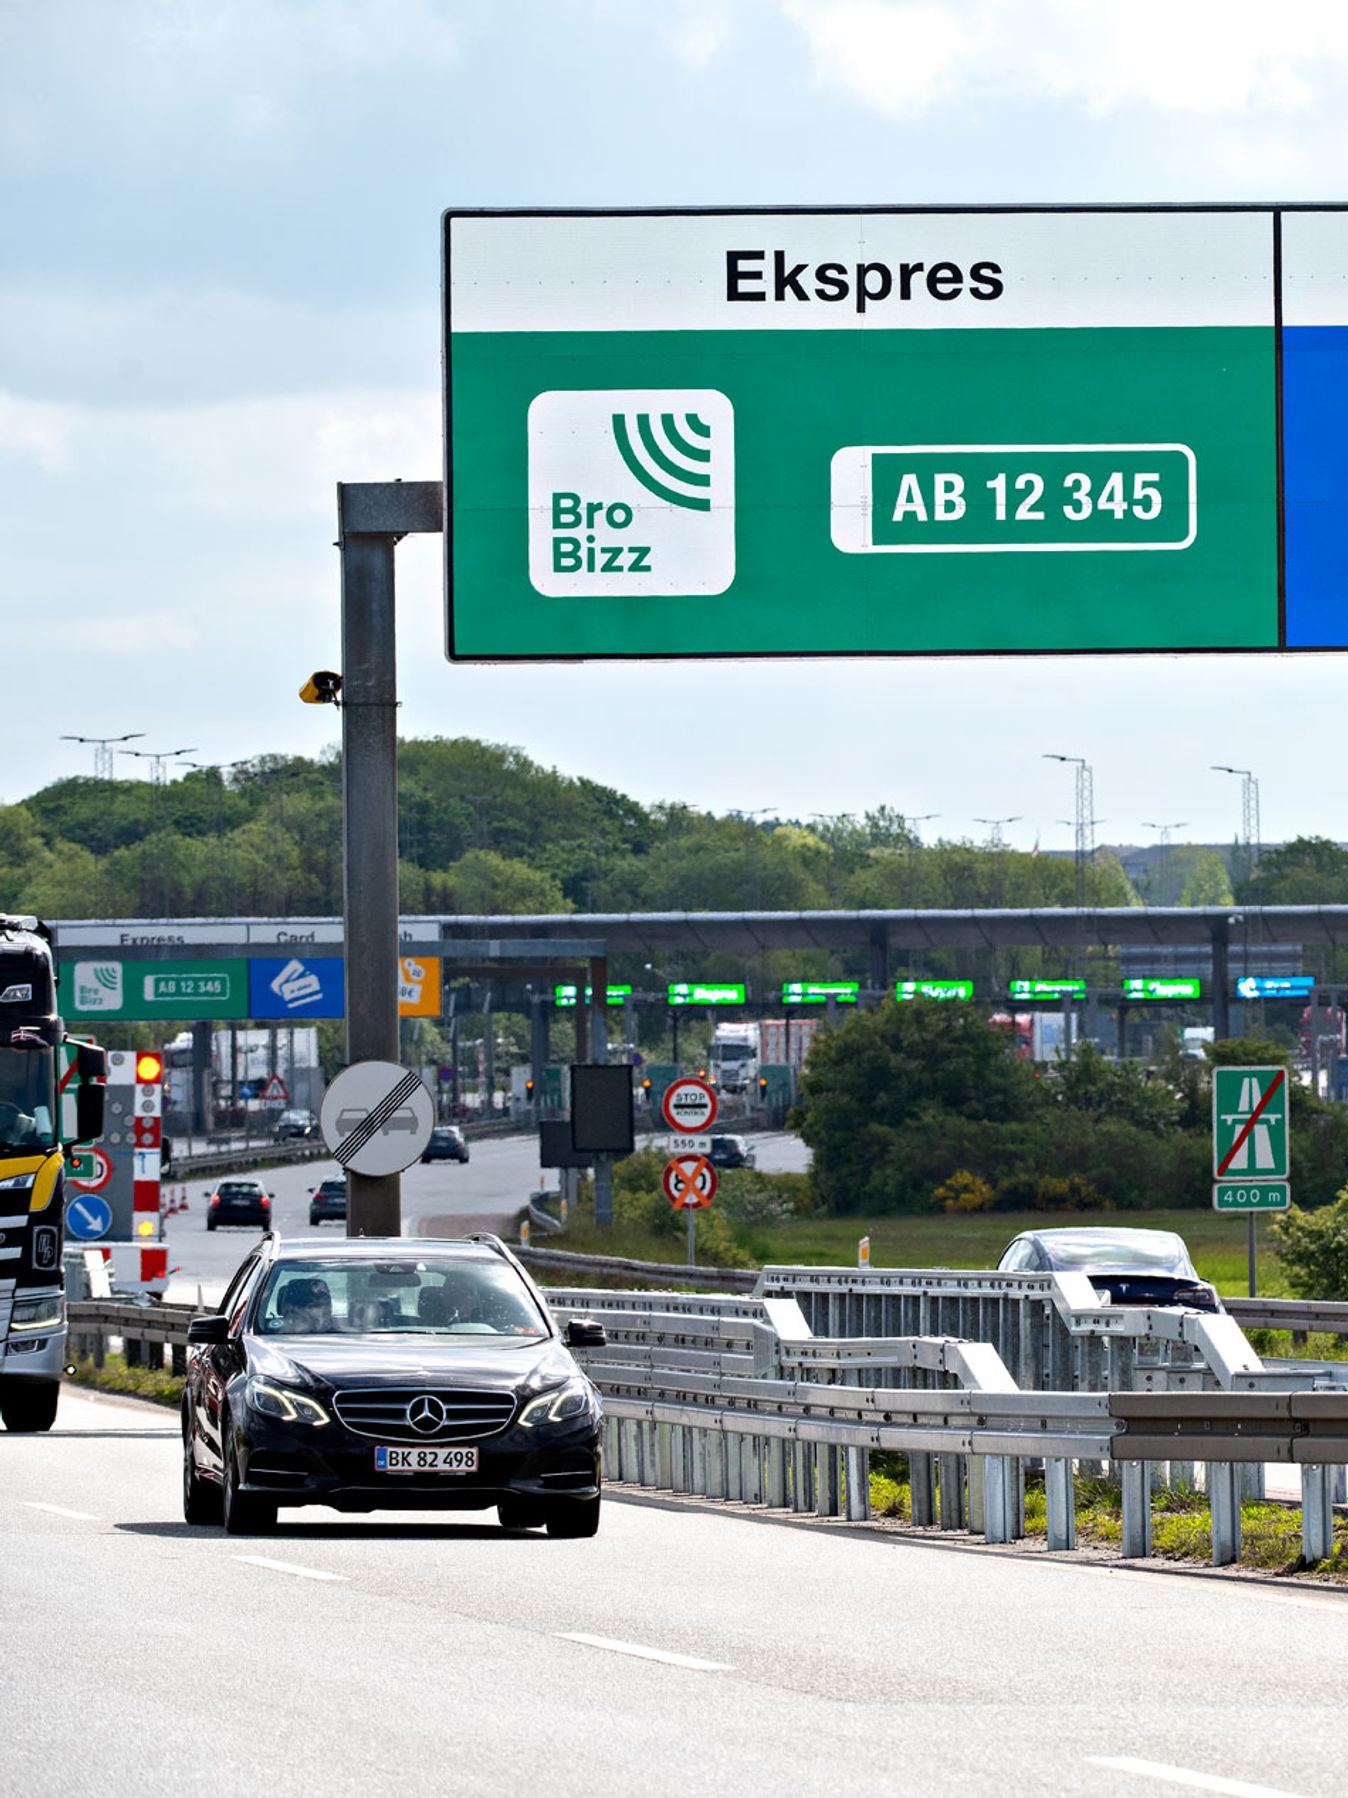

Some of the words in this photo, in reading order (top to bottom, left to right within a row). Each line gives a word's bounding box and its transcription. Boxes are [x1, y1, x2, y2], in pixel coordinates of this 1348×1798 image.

[726, 249, 1004, 313] Ekspres
[892, 473, 967, 522] AB
[986, 473, 1045, 521] 12
[1062, 472, 1163, 521] 345
[551, 492, 634, 530] Bro
[551, 536, 652, 573] Bizz
[276, 931, 316, 943] Card
[158, 979, 177, 994] AB
[180, 980, 194, 993] 12
[198, 979, 222, 994] 345
[675, 1092, 706, 1103] STOP
[673, 1138, 696, 1149] 550
[698, 1141, 707, 1149] m
[1223, 1188, 1261, 1203] 400
[1268, 1191, 1281, 1202] m
[388, 1450, 413, 1468] BK
[416, 1450, 439, 1468] 82
[442, 1450, 475, 1468] 498
